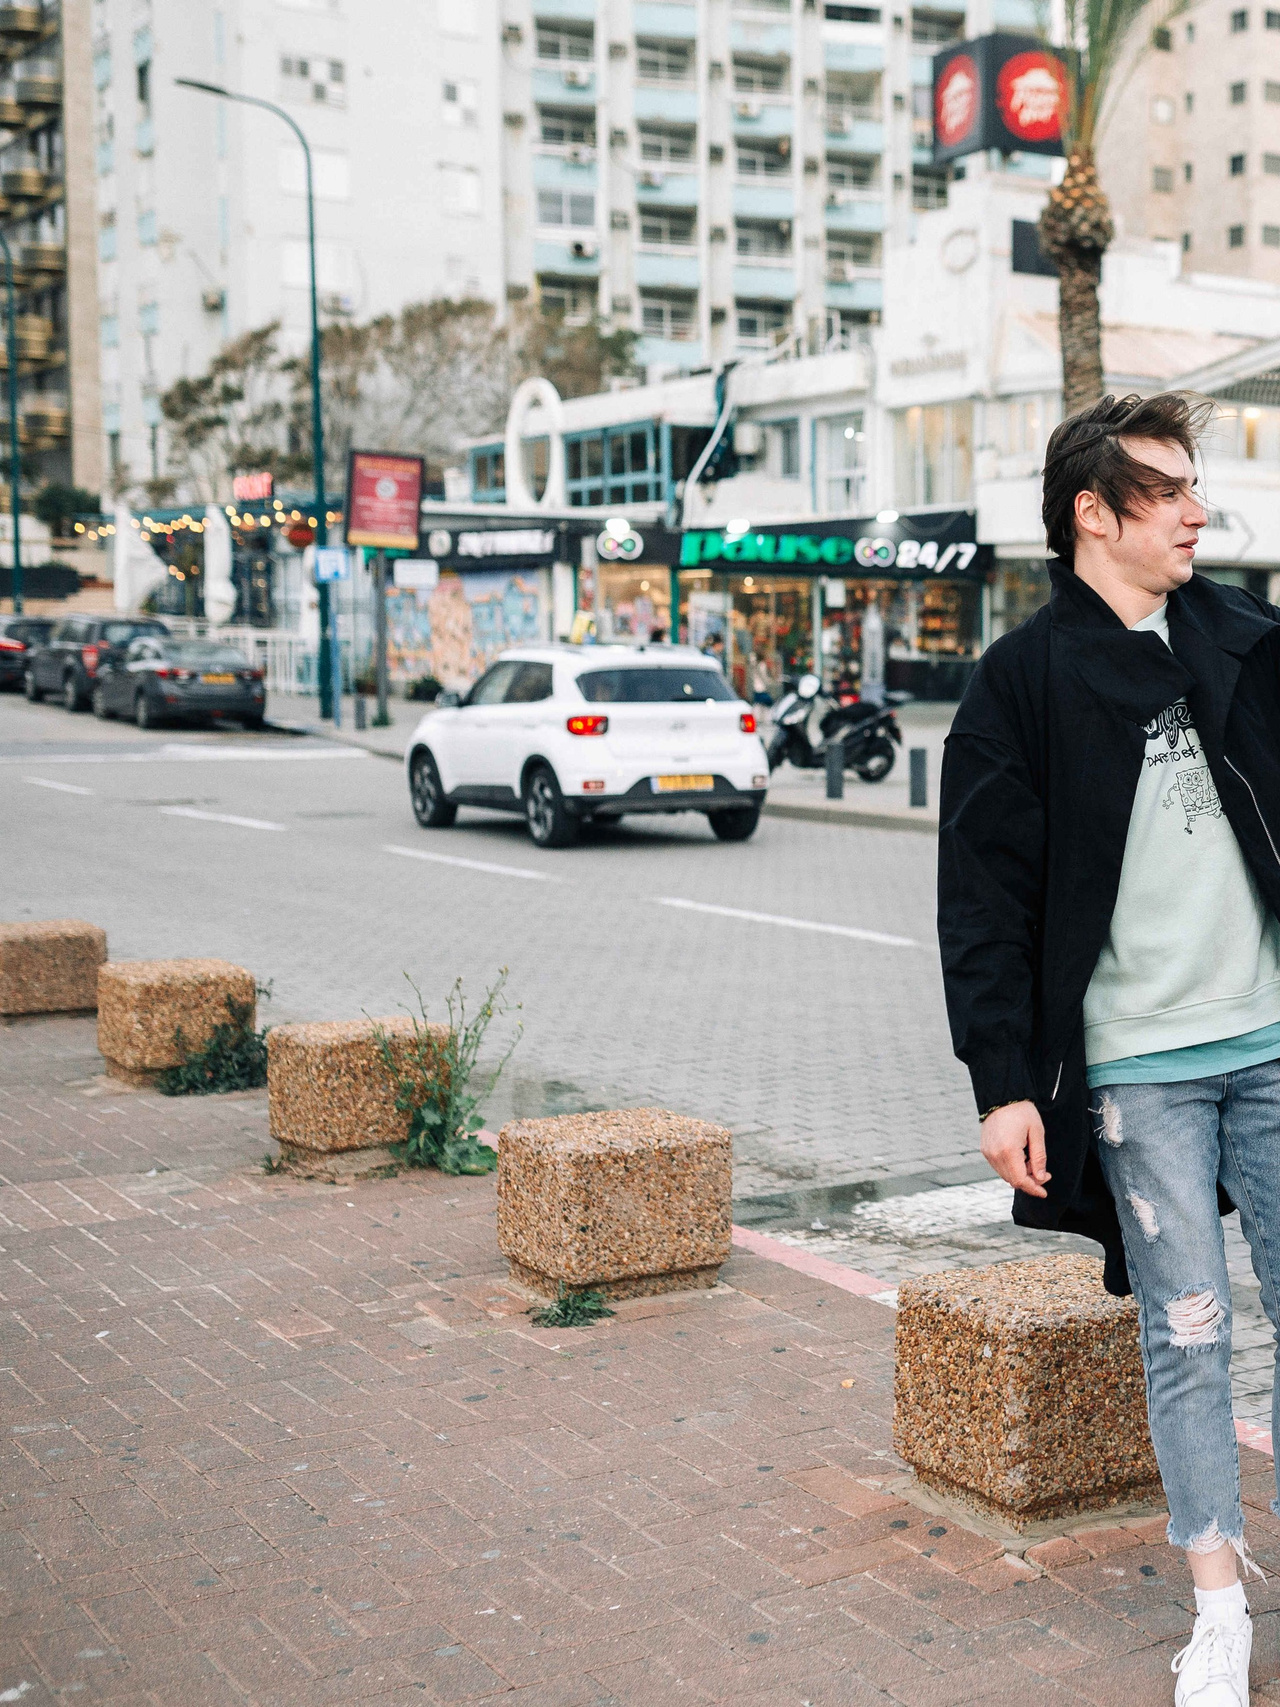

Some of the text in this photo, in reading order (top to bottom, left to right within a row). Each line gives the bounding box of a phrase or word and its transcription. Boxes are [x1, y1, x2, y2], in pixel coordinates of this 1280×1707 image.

[680, 531, 978, 573] pause 24/7
[1146, 745, 1199, 767] DARE TO BE
